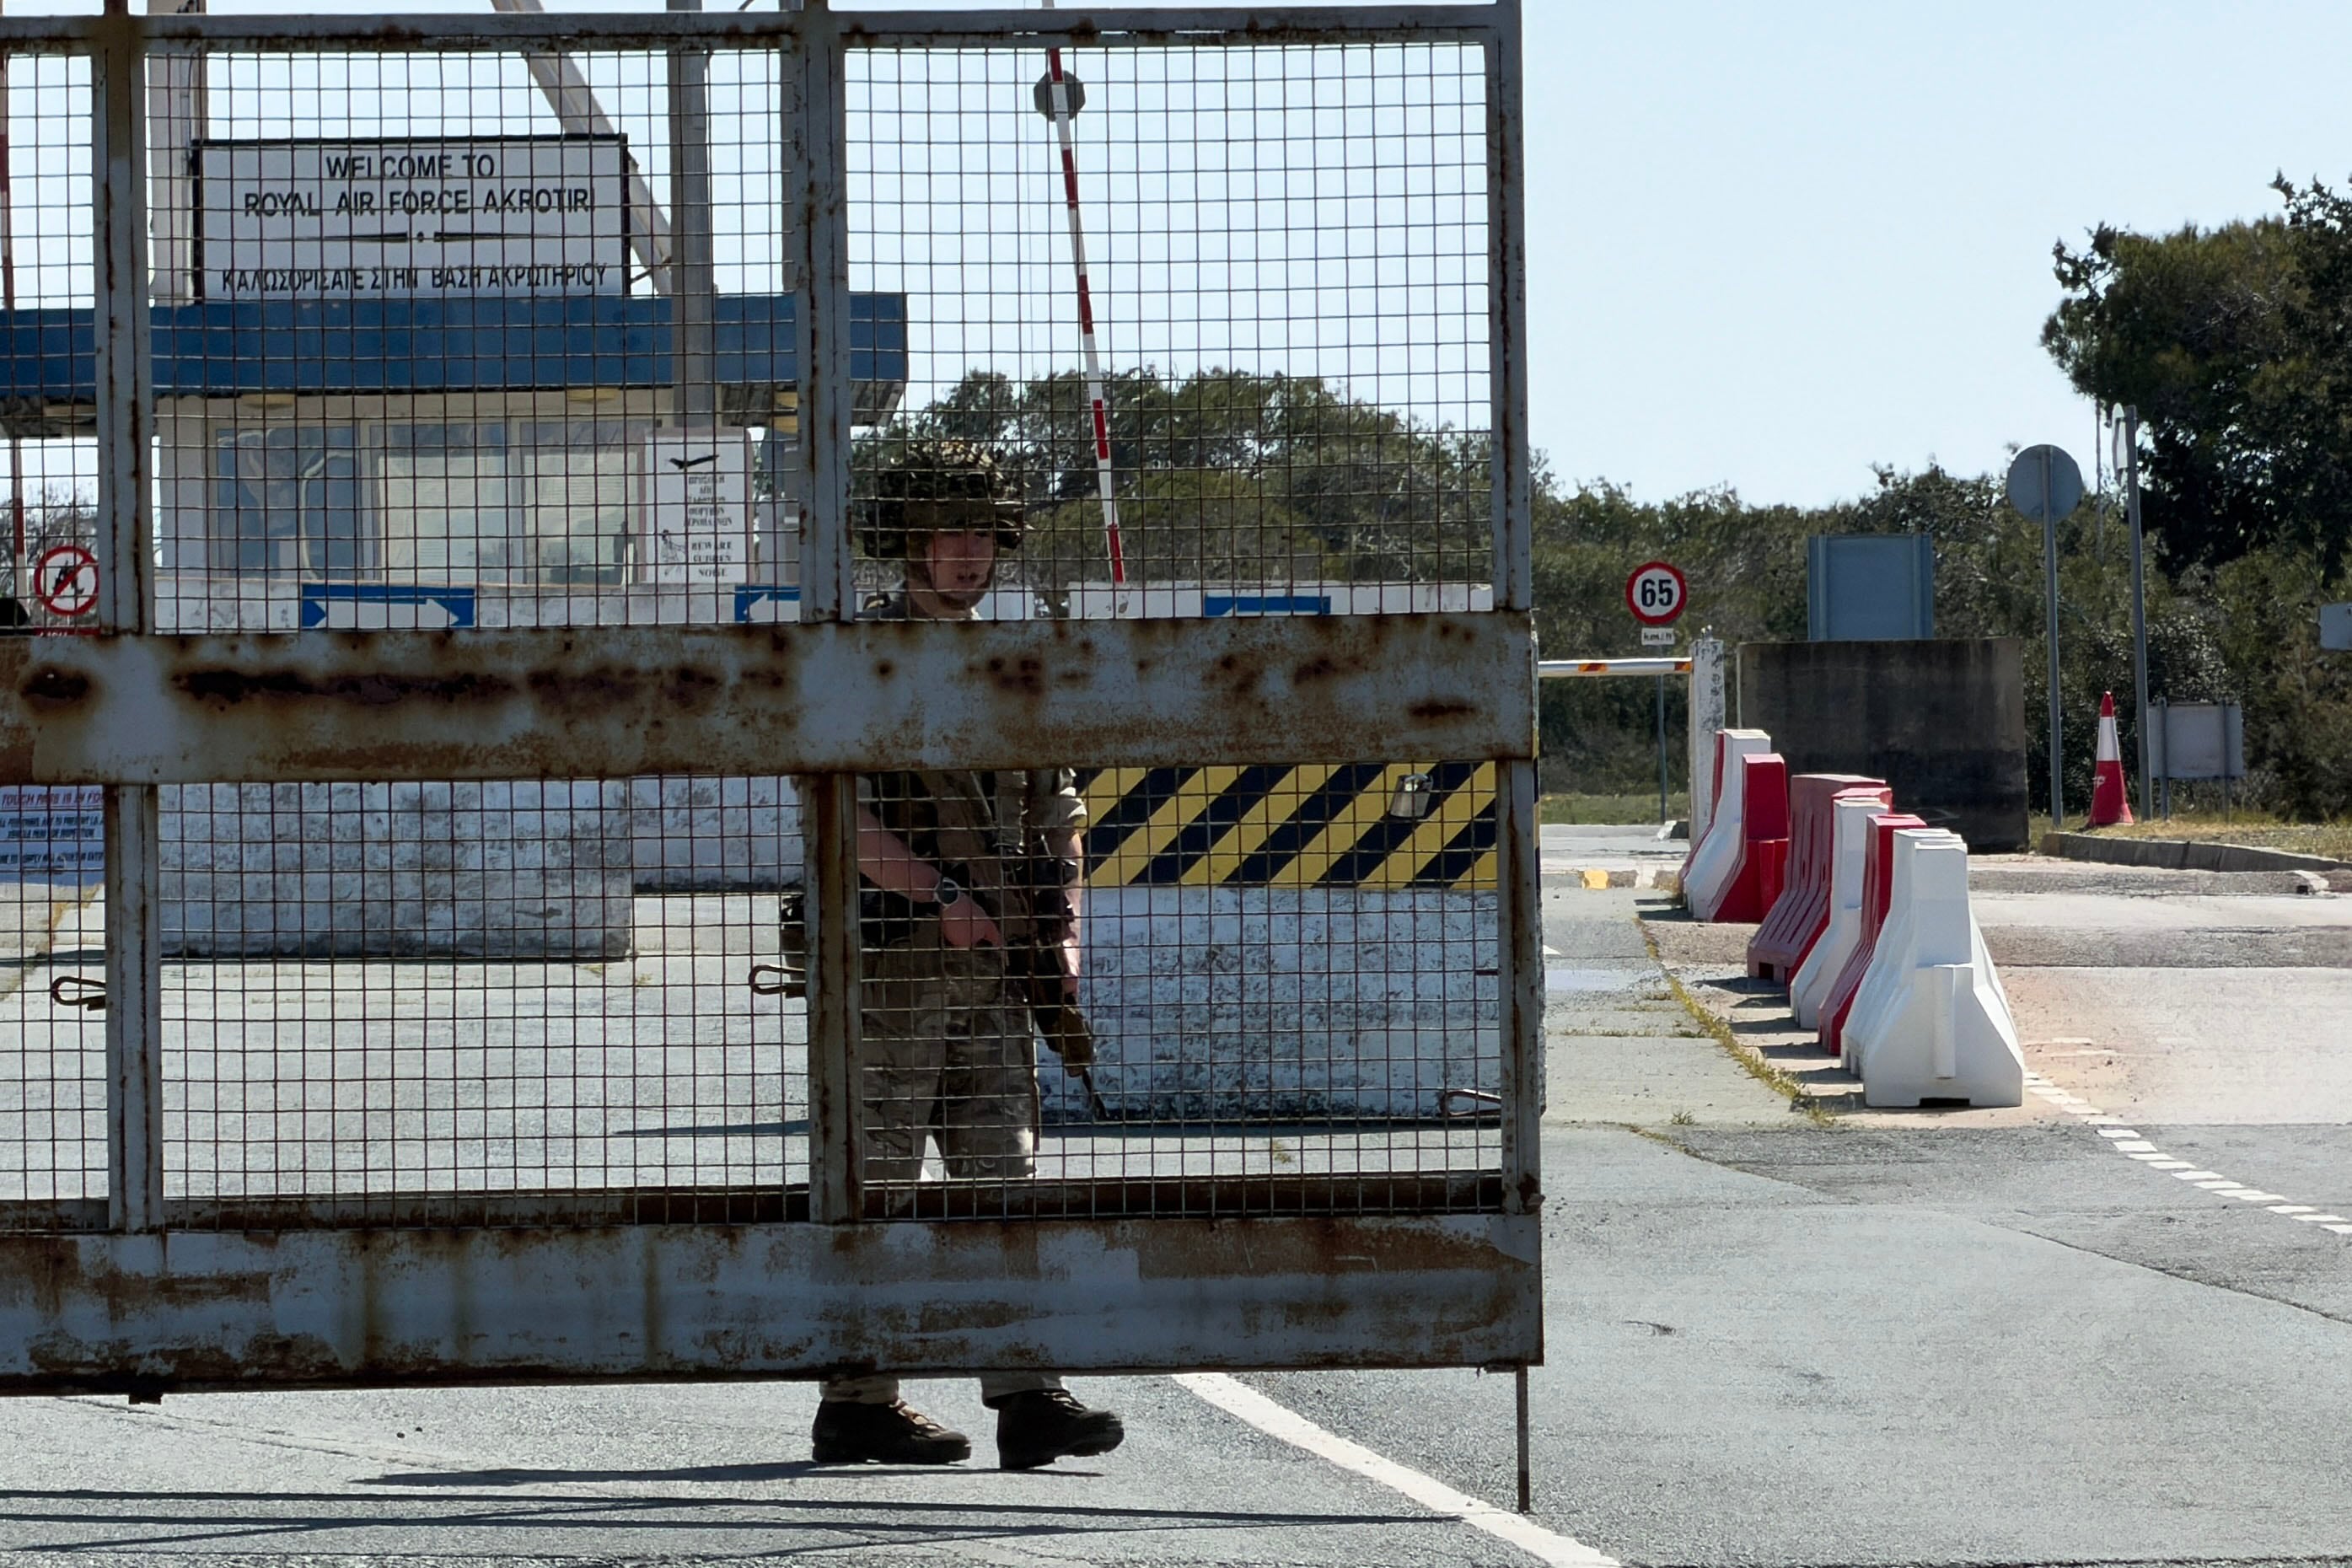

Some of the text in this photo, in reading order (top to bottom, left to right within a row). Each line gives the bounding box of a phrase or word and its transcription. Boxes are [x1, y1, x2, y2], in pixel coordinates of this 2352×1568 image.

[326, 153, 495, 178] WELCOME TO
[244, 191, 322, 217] ROYAL
[336, 191, 376, 217] AIR
[389, 189, 470, 216] FORCE
[431, 264, 481, 289] ΒΑΣΗ
[1640, 578, 1673, 607] 65
